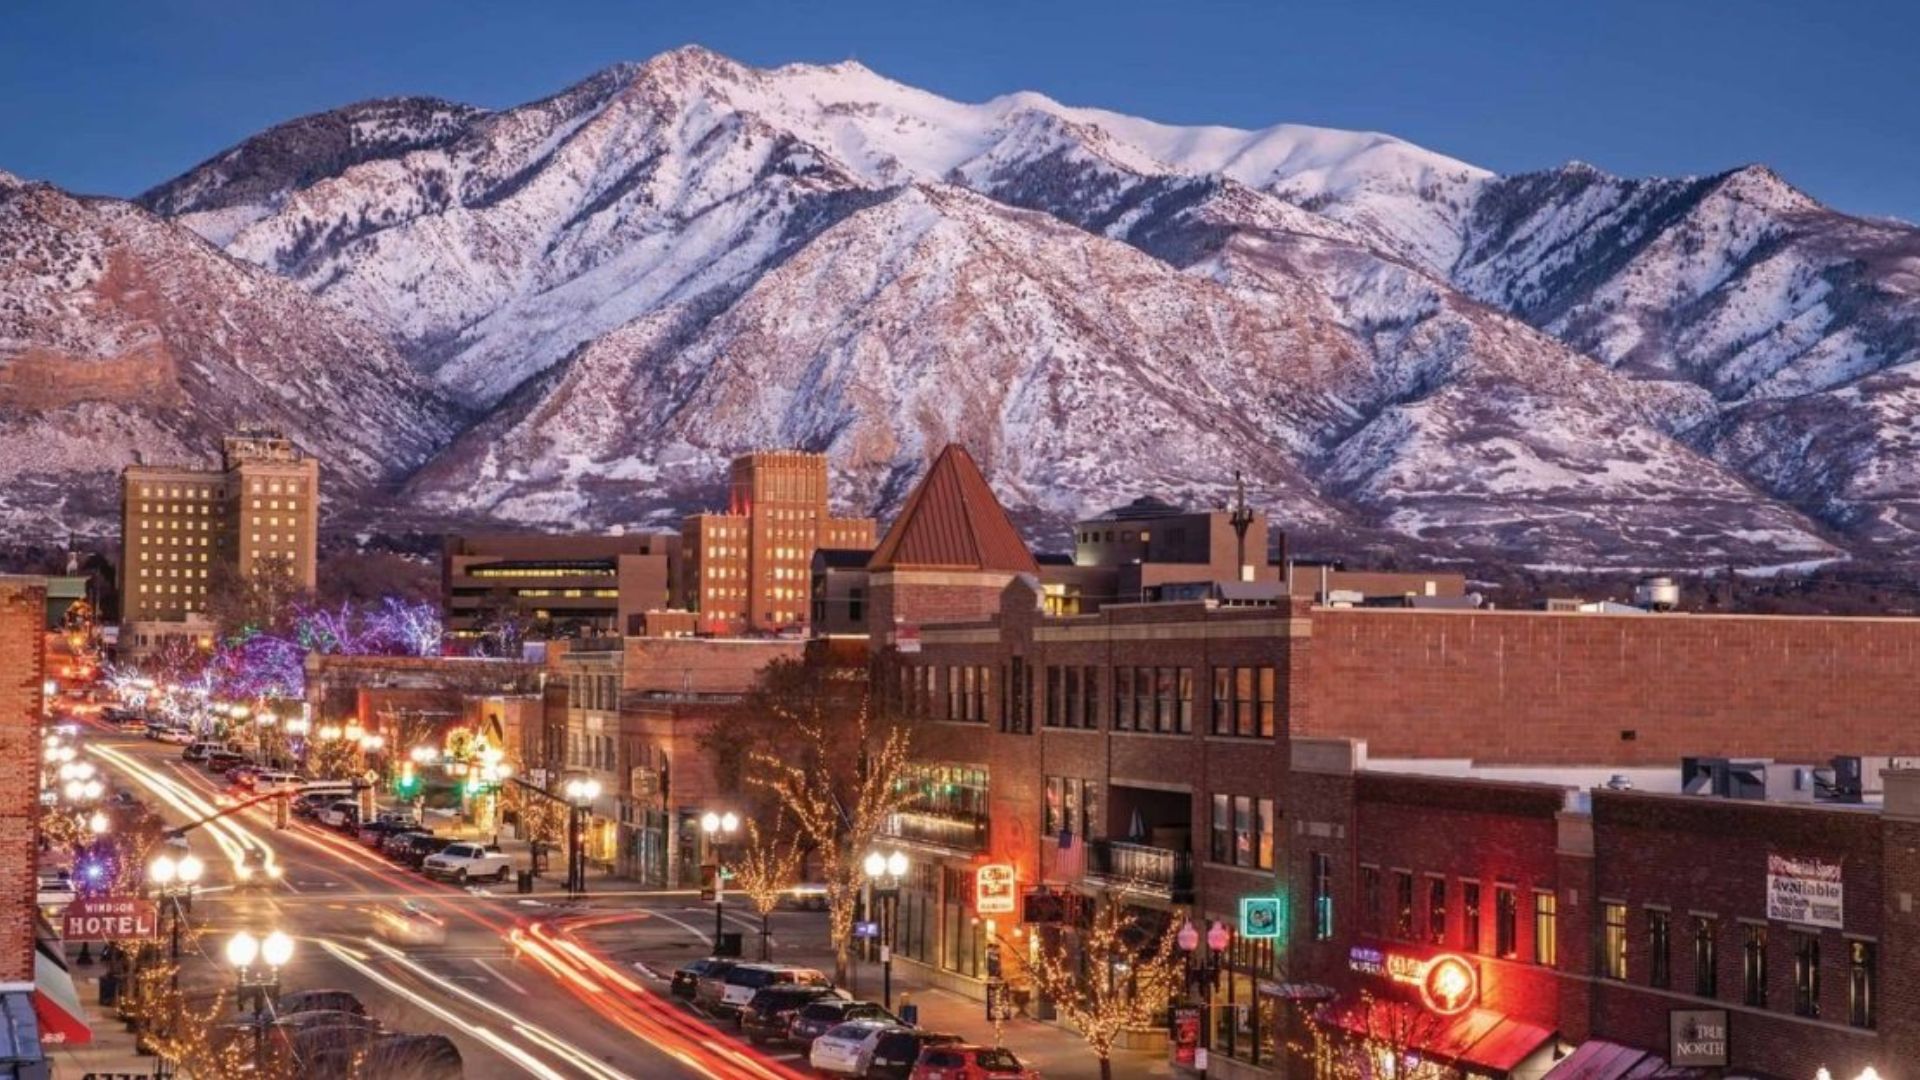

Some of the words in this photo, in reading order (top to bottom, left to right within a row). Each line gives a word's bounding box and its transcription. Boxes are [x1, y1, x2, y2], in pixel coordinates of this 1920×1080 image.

[1772, 878, 1840, 898] Available
[69, 917, 150, 935] HOTEL
[1677, 1042, 1724, 1057] NORTH
